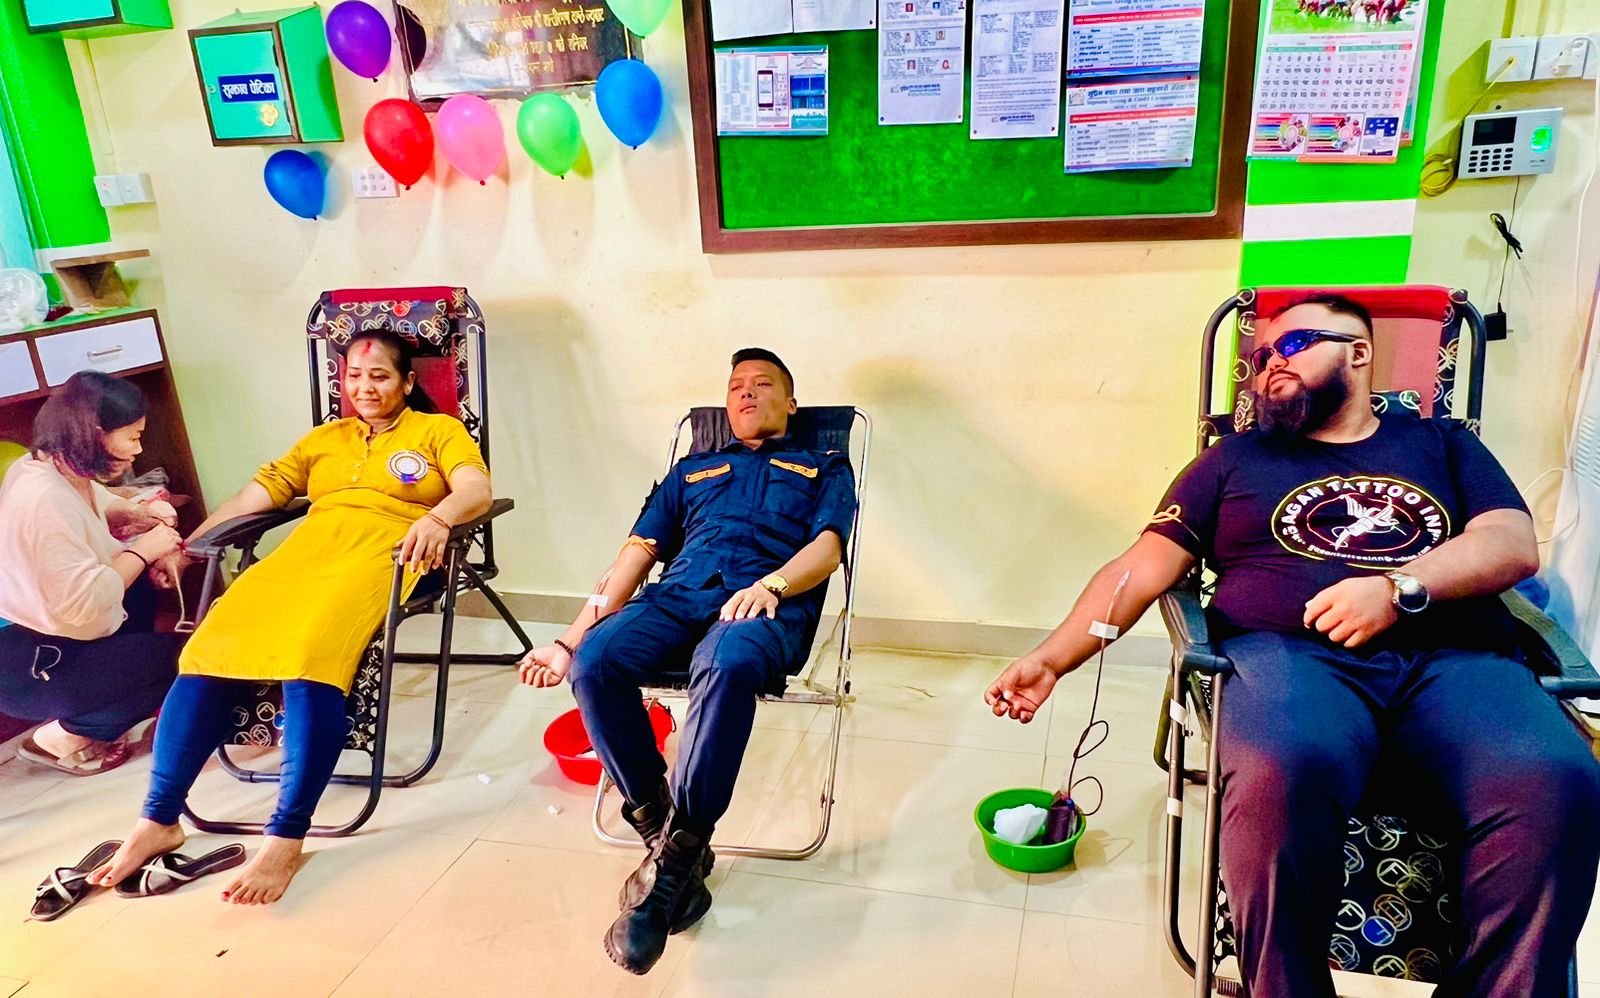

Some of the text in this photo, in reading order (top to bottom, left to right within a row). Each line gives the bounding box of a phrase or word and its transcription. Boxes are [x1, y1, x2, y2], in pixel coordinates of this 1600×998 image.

[249, 79, 276, 95] पेटिका
[1281, 486, 1324, 537] SAGAN
[1326, 480, 1421, 505] TATTOO
